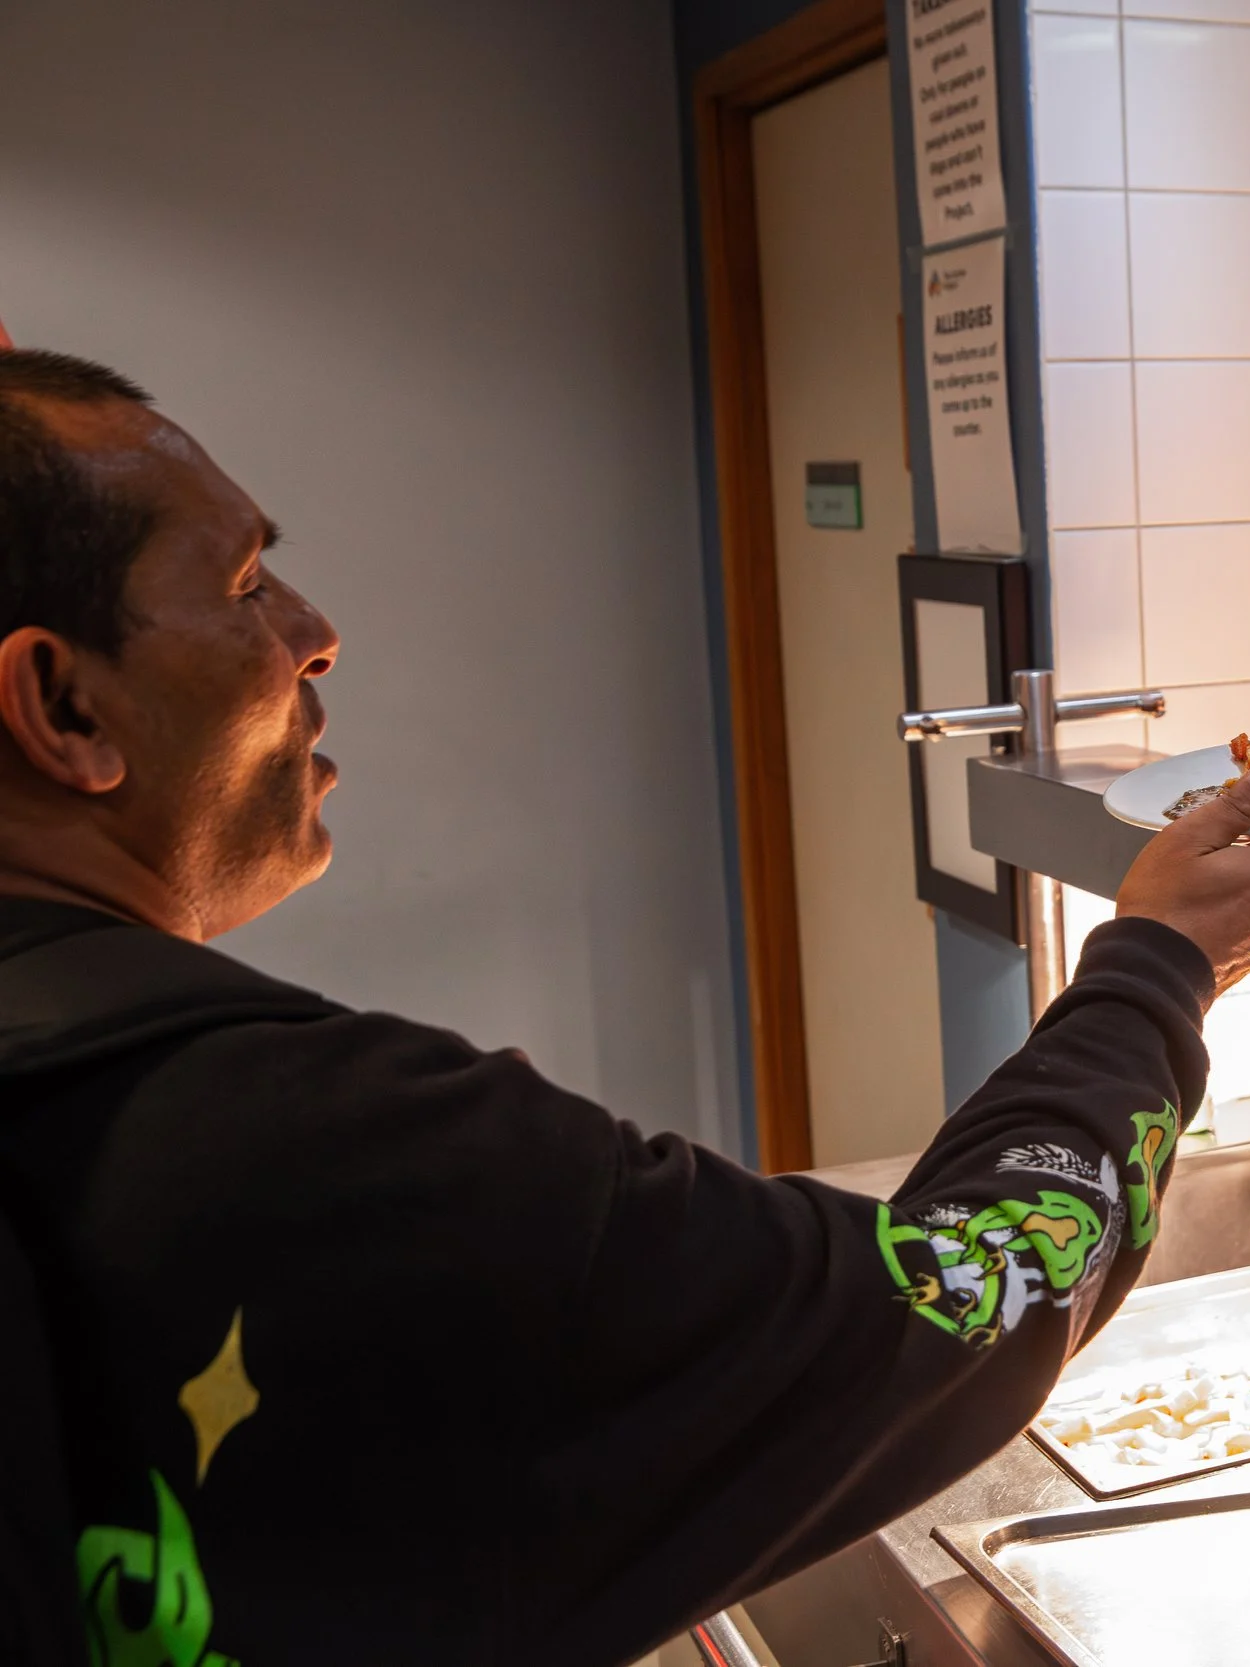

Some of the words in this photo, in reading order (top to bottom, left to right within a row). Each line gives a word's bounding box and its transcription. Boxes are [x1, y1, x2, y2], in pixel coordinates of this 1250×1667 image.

[950, 70, 975, 92] people
[968, 172, 982, 187] the
[935, 304, 993, 335] ALLERGIES
[932, 350, 954, 365] Please
[955, 346, 978, 361] inform
[946, 372, 974, 389] allergies
[985, 370, 999, 385] you
[940, 399, 960, 413] come
[979, 395, 992, 408] the
